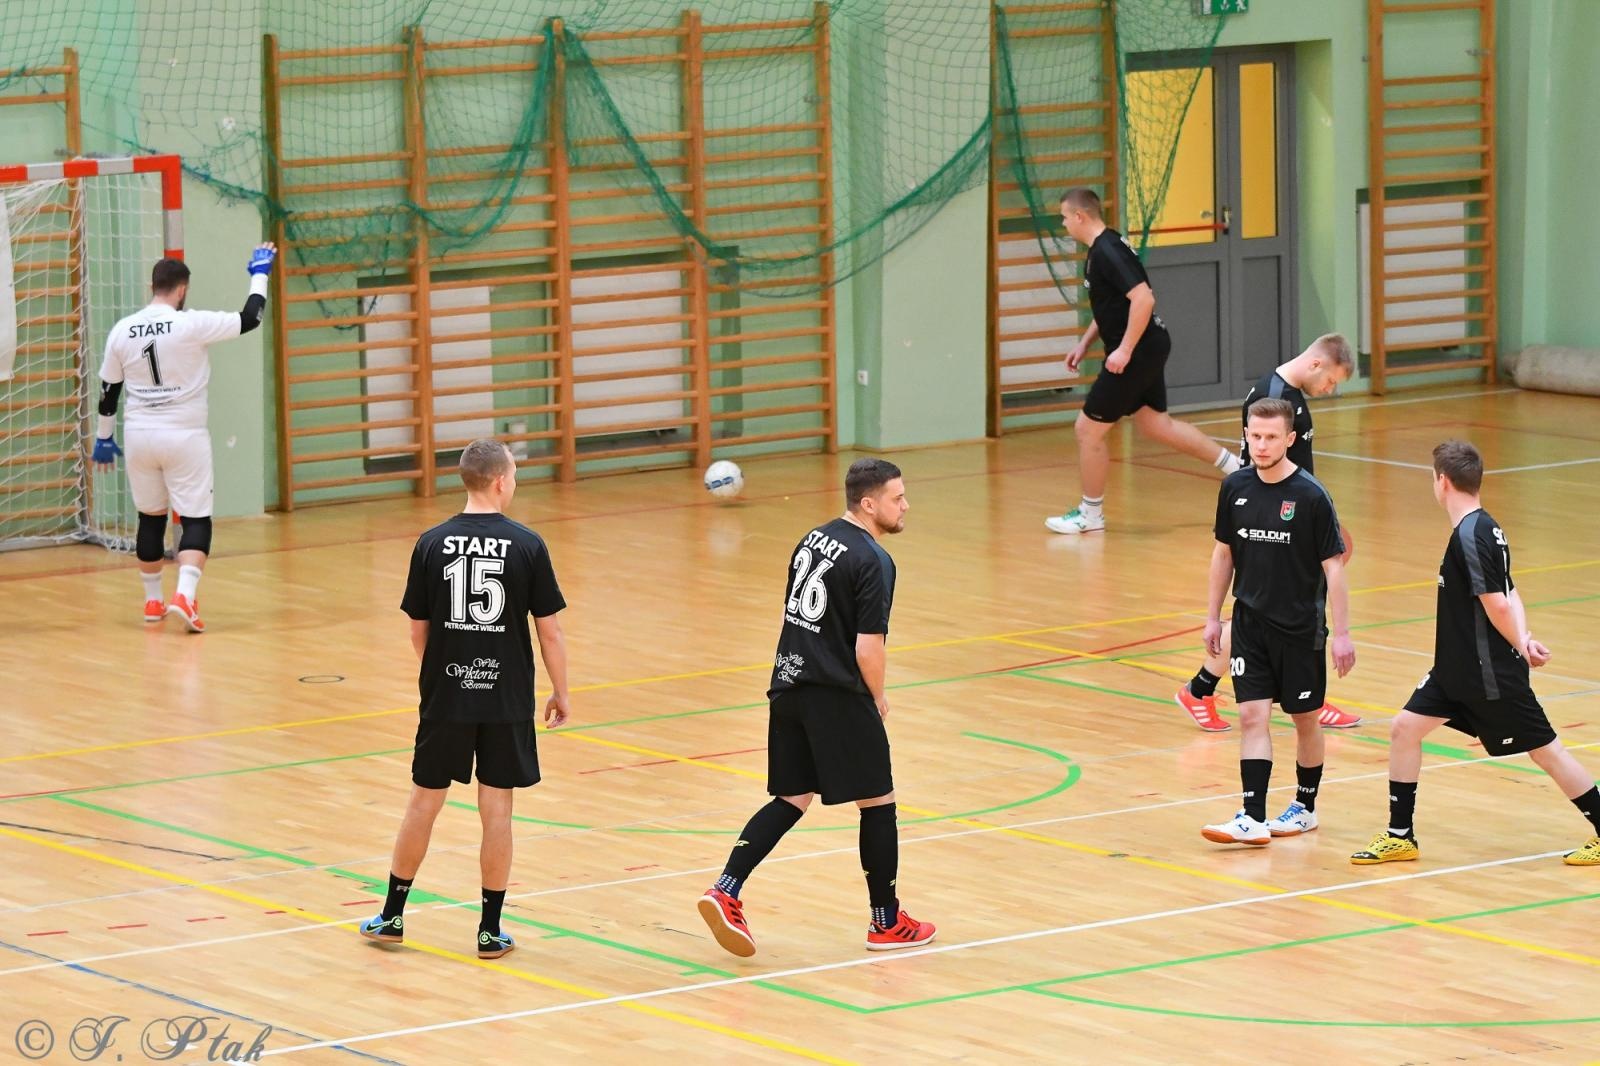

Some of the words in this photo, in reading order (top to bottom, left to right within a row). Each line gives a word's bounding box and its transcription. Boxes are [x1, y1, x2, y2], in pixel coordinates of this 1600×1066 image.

[129, 321, 173, 338] START
[142, 339, 163, 386] 1
[442, 536, 512, 558] START
[803, 529, 848, 561] START
[443, 556, 506, 625] 15
[787, 546, 834, 622] 26
[446, 663, 500, 680] Wiktoria
[472, 657, 500, 669] Willa
[1230, 656, 1245, 676] 20
